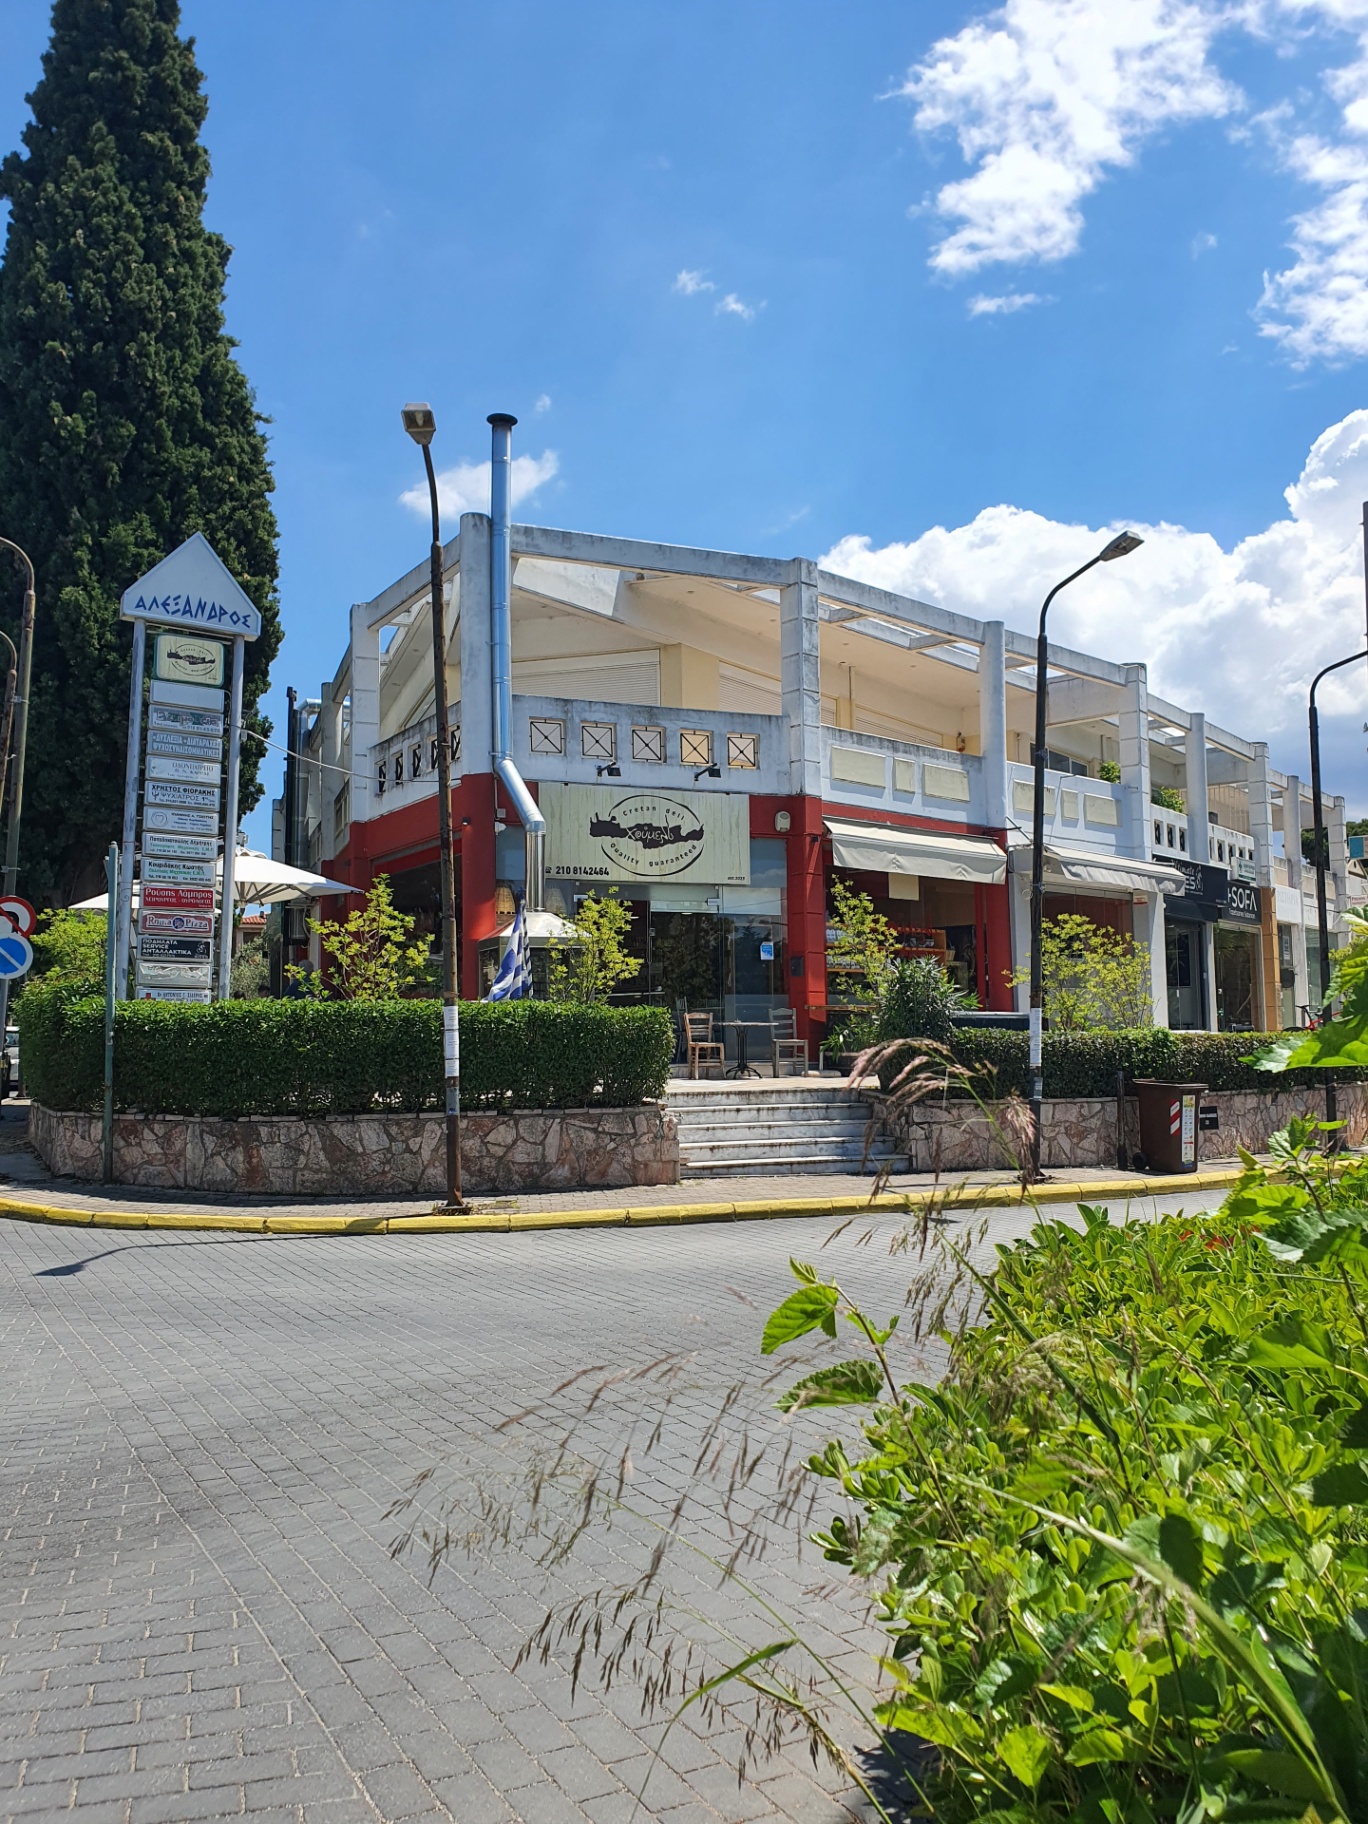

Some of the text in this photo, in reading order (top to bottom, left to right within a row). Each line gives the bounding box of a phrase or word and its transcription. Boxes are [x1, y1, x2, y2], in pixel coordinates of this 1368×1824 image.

[135, 594, 251, 629] ΑΛΕΞΑΝΔΡΟΣ
[152, 785, 181, 793] ΧΡΗΣΤΟΣ
[161, 792, 200, 801] ΨΥΧΙΑΤΡΟΣ
[623, 806, 684, 821] Cretan deli
[610, 843, 697, 867] Quality guaranteed
[556, 866, 609, 876] 210 8142464
[145, 888, 212, 898] Ρούσης Λάμπρος
[186, 918, 208, 927] Pizza
